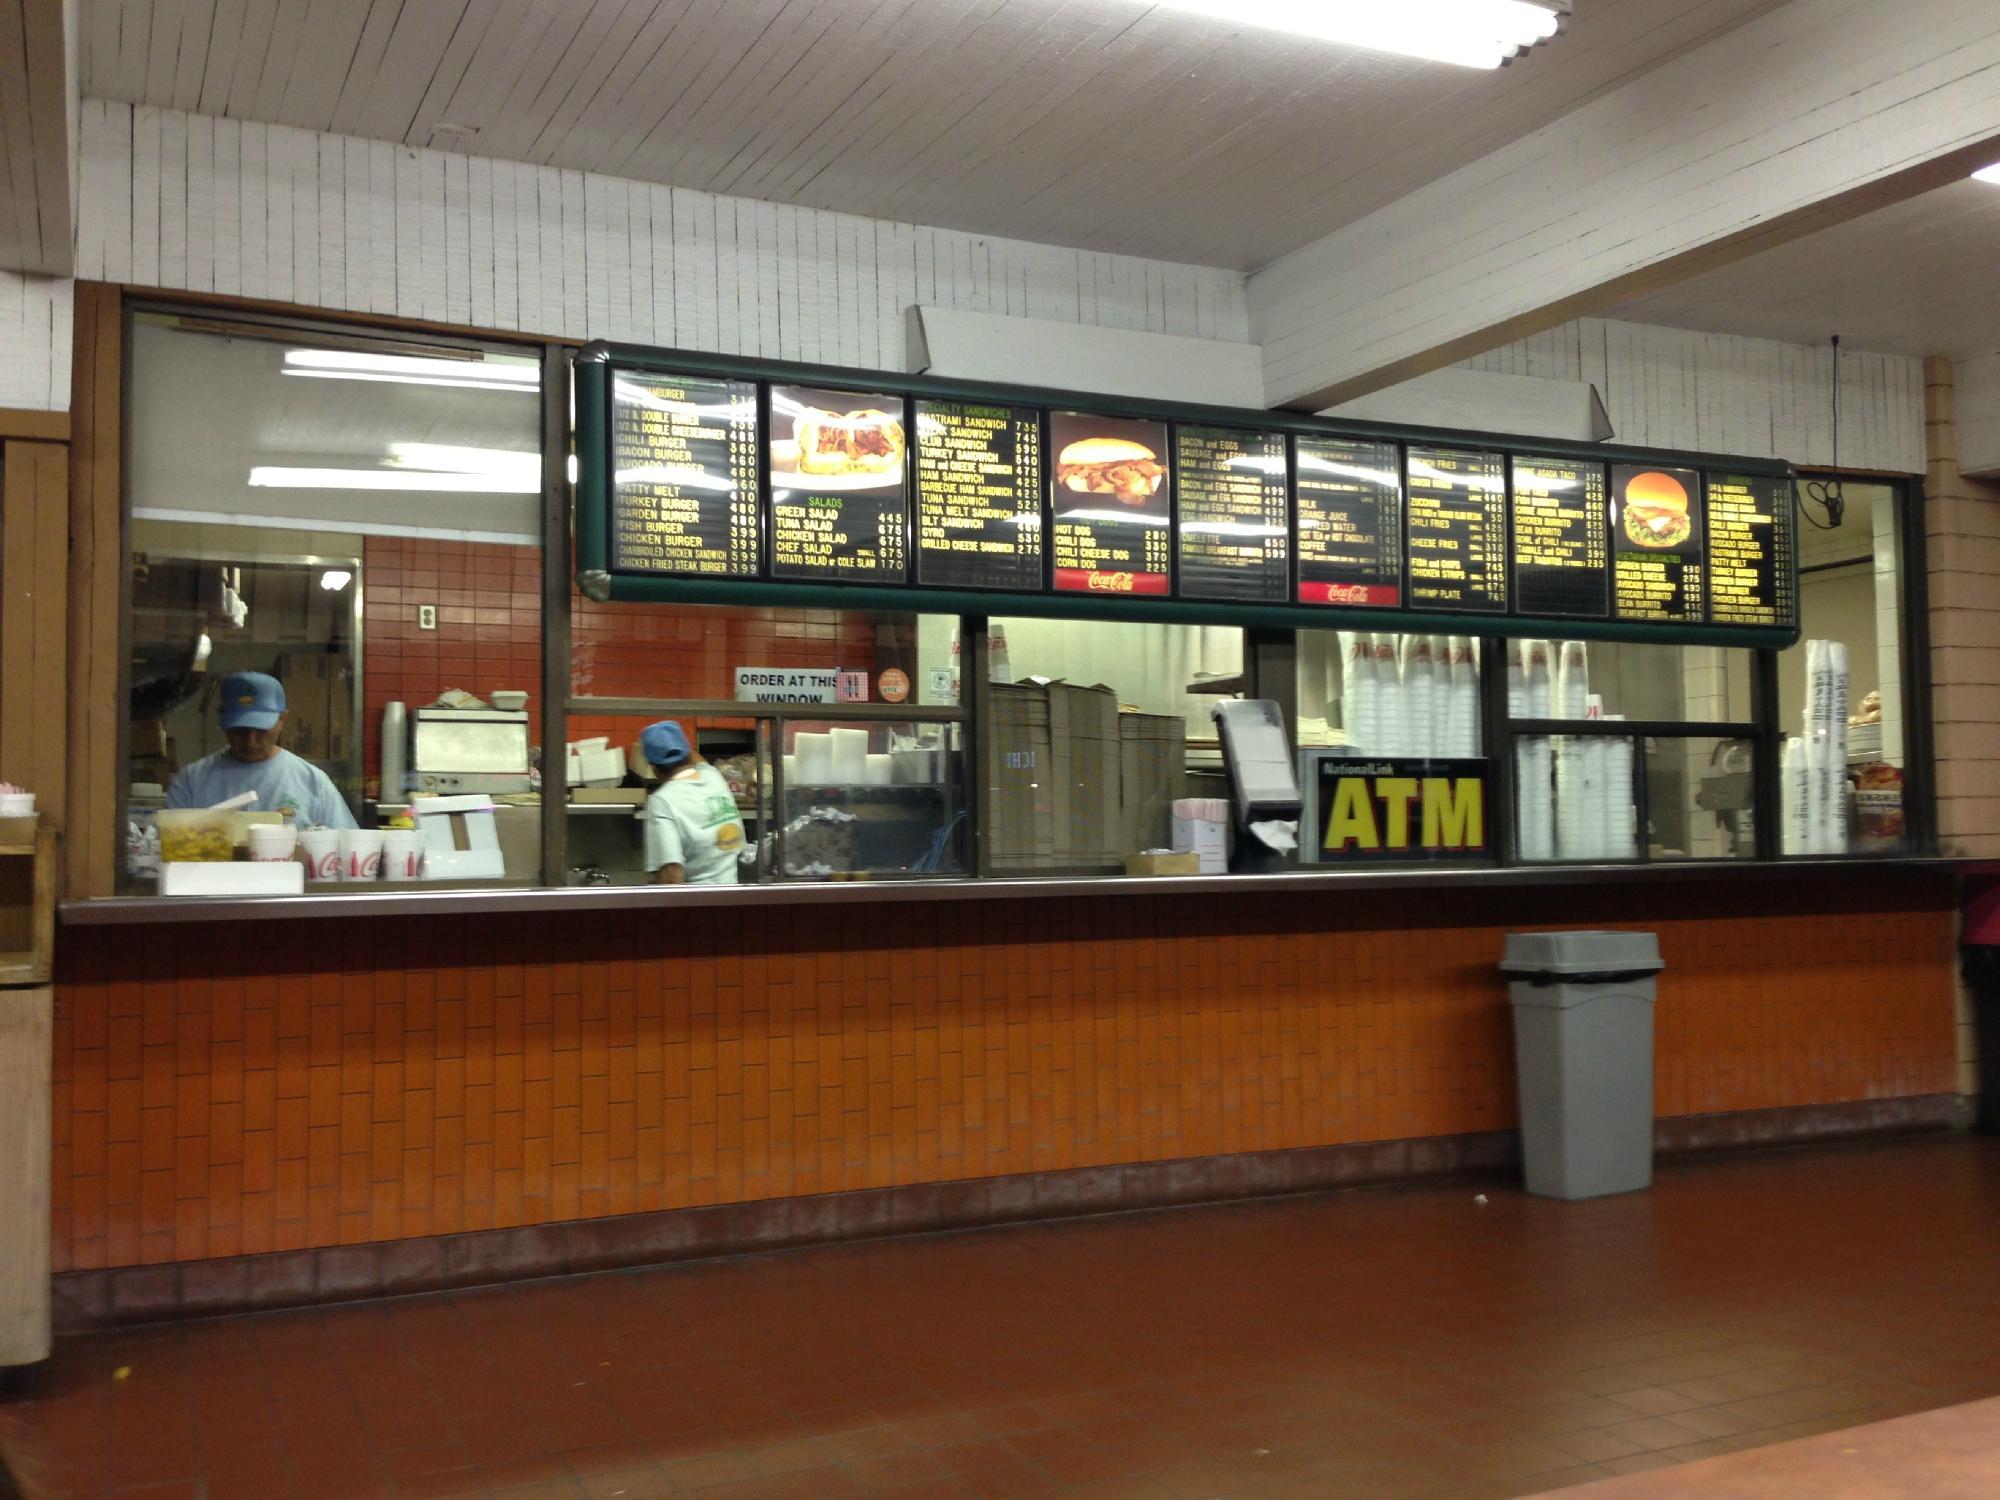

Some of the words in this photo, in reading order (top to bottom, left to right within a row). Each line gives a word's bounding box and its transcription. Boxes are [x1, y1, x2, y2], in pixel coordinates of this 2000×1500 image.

[642, 411, 668, 423] DOUBLE
[964, 417, 1006, 429] SANDWICH
[642, 423, 669, 436] DOUBLE
[950, 427, 992, 439] SANDWICH
[1015, 432, 1036, 443] 745
[619, 434, 643, 446] CHILI
[648, 436, 686, 448] BURGER
[729, 442, 755, 453] 360
[920, 436, 941, 446] CLUB
[944, 437, 986, 450] SANDWICH
[1015, 443, 1037, 454] 590
[1180, 437, 1202, 447] BACON
[1220, 440, 1238, 450] EGGS
[1263, 444, 1282, 454] 625
[619, 446, 650, 457] BACON
[654, 448, 691, 460] BURGER
[729, 454, 755, 465] 460
[920, 447, 953, 459] TURKEY
[956, 450, 998, 462] SANDWICH
[1016, 455, 1037, 465] 540
[1180, 447, 1211, 459] SAUSAGE
[729, 466, 755, 477] 460
[950, 460, 975, 471] CHEESE
[1016, 466, 1037, 476] 475
[1180, 458, 1196, 468] HAM
[1212, 461, 1231, 471] EGGS
[1437, 459, 1456, 469] FRIES
[1484, 464, 1501, 473] 245
[920, 470, 938, 480] HAM
[942, 471, 983, 483] SANDWICH
[1016, 477, 1037, 487] 425
[1560, 470, 1575, 479] TACO
[1585, 472, 1601, 481] 375
[653, 485, 679, 496] MELT
[730, 490, 755, 501] 410
[920, 481, 956, 493] BARBECUE
[959, 484, 974, 494] HAM
[977, 485, 1012, 496] SANDWICH
[1016, 488, 1038, 498] 425
[1215, 482, 1227, 491] EGG
[1585, 482, 1601, 491] 375
[808, 496, 842, 507] SALADS
[921, 493, 943, 503] TUNA
[946, 494, 988, 506] SANDWICH
[1017, 499, 1038, 509] 525
[1585, 492, 1601, 500] 425
[620, 495, 656, 507] TURKEY
[661, 498, 698, 509] BURGER
[730, 502, 755, 514] 480
[921, 504, 943, 514] TUNA
[946, 505, 968, 516] MELT
[972, 507, 1012, 518] SANDWICH
[620, 508, 657, 520] GARDEN
[661, 510, 699, 522] BURGER
[776, 505, 805, 517] GREEN
[808, 507, 838, 519] SALAD
[878, 512, 901, 523] 445
[1329, 511, 1347, 521] JUICE
[1516, 515, 1542, 525] CHICKEN
[620, 520, 640, 531] FISH
[646, 521, 683, 533] BURGER
[730, 526, 755, 537] 399
[776, 517, 799, 529] TUNA
[803, 519, 832, 530] SALAD
[879, 524, 902, 535] 675
[922, 516, 937, 526] BLT
[941, 517, 983, 528] SANDWICH
[1332, 522, 1356, 532] WATER
[1411, 517, 1428, 527] CHILI
[1430, 519, 1449, 528] FRIES
[1485, 523, 1502, 532] 425
[776, 529, 814, 542] CHICKEN
[818, 532, 846, 543] SALAD
[879, 535, 902, 546] 675
[922, 527, 944, 537] GYRO
[1055, 523, 1071, 534] HOT
[1074, 525, 1090, 535] DOG
[1145, 530, 1165, 541] 280
[1516, 525, 1532, 534] BEAN
[1535, 526, 1561, 536] BURRITO
[620, 532, 660, 544] CHICKEN
[665, 535, 702, 546] BURGER
[730, 538, 755, 549] 399
[921, 538, 950, 549] GRILLED
[952, 540, 977, 551] CHEESE
[980, 541, 1013, 552] SANDWICH
[1018, 544, 1039, 554] 275
[1056, 535, 1076, 546] CHILI
[1080, 537, 1095, 547] DOG
[1299, 540, 1325, 550] COFFEE
[1411, 537, 1436, 547] CHEESE
[1438, 539, 1458, 549] FRIES
[1486, 543, 1503, 552] 310
[1542, 536, 1558, 545] CHILI
[666, 546, 693, 557] CHICKEN
[695, 548, 726, 559] SANDWICH
[730, 550, 755, 561] 599
[776, 541, 799, 552] CHEF
[803, 543, 831, 554] SALAD
[879, 547, 902, 558] 675
[1056, 545, 1076, 556] CHILI
[1080, 547, 1110, 558] CHEESE
[1113, 549, 1128, 560] DOG
[1145, 552, 1166, 562] 370
[1265, 549, 1285, 558] 599
[1555, 547, 1571, 556] CHILI
[619, 556, 650, 568] CHICKEN
[652, 558, 672, 569] FRIED
[675, 559, 697, 570] STEAK
[700, 560, 726, 571] BURGER
[730, 562, 755, 573] 399
[776, 553, 802, 564] POTATO
[805, 555, 826, 565] SALAD
[838, 556, 854, 567] COLE
[857, 557, 875, 568] SLAW
[881, 559, 902, 570] 170
[1057, 557, 1077, 567] CORN
[1081, 559, 1096, 568] DOG
[1145, 563, 1166, 572] 225
[1485, 562, 1503, 571] 745
[1412, 567, 1439, 578] CHICKEN
[1486, 572, 1503, 581] 445
[1414, 588, 1438, 597] SHRIMP
[1439, 589, 1460, 598] PLATE
[740, 674, 785, 687] ORDER
[789, 675, 804, 687] AT
[1323, 762, 1394, 776] NationalLink
[1323, 777, 1483, 850] ATM
